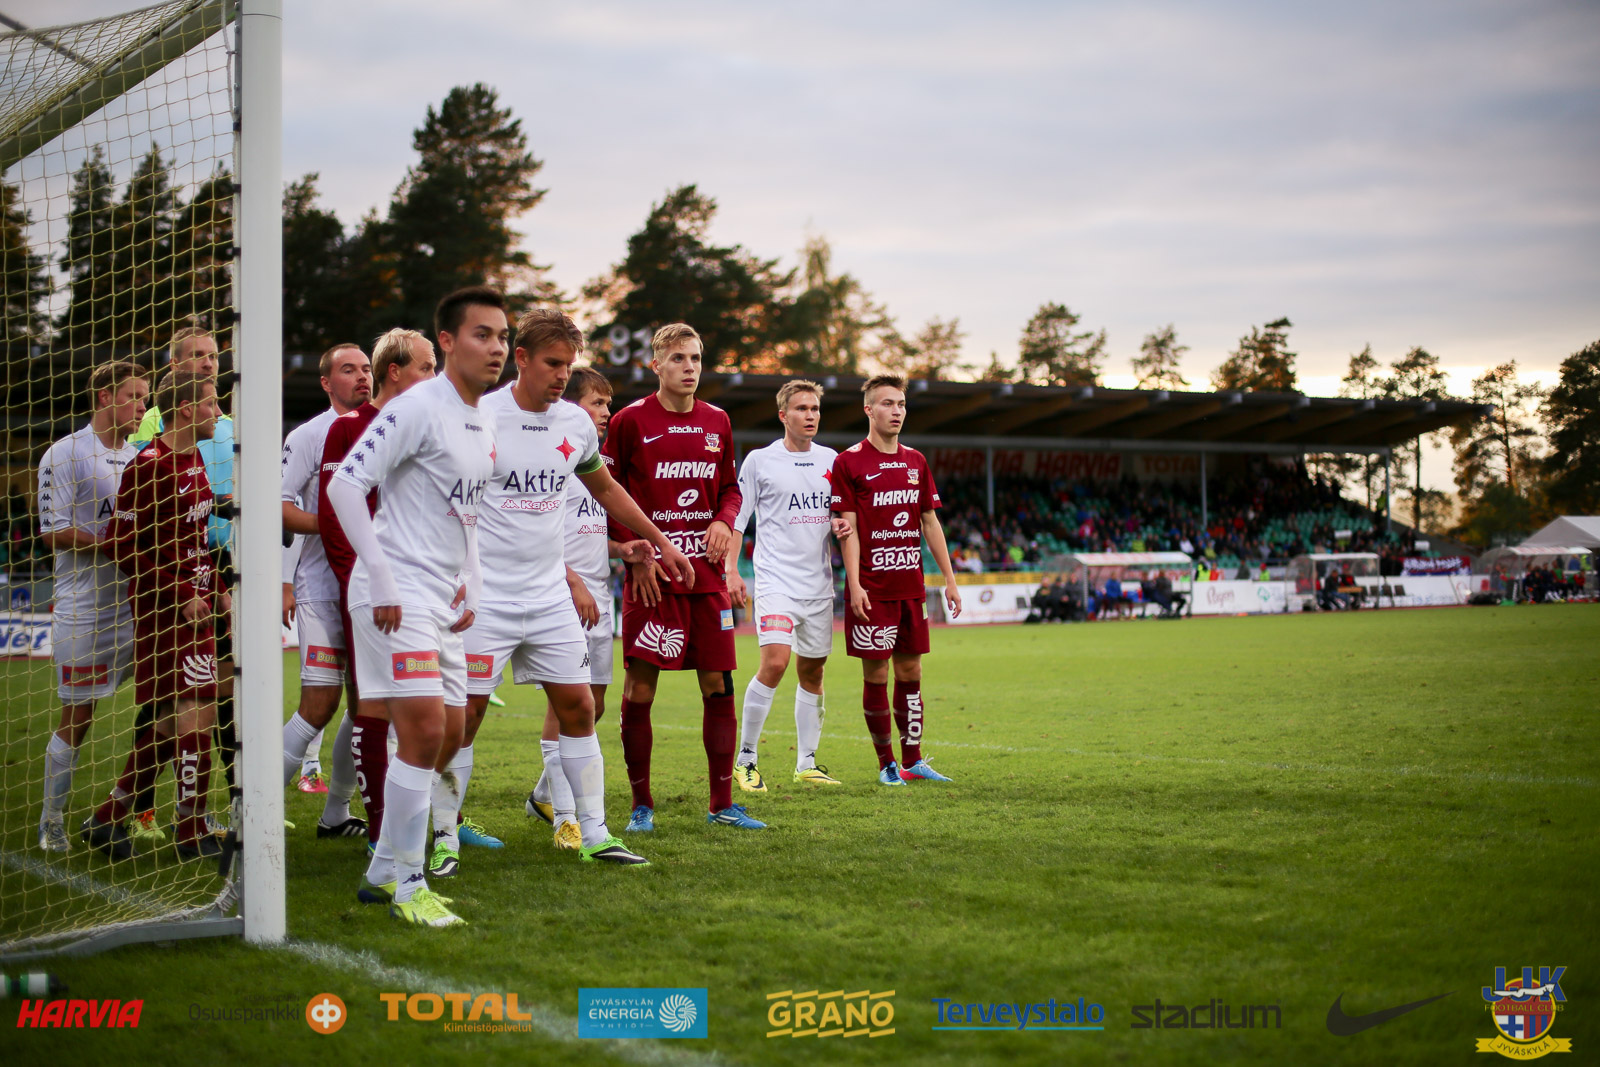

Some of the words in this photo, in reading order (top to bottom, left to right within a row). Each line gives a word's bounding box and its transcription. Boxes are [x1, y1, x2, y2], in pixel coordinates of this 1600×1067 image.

[668, 425, 703, 434] stadium
[655, 462, 717, 479] HARVIA
[879, 461, 908, 470] stadium
[1036, 452, 1121, 478] HARVIA
[503, 469, 566, 493] Aktia
[448, 478, 486, 505] Akti
[873, 490, 919, 506] HARVIA
[521, 500, 561, 511] Kappa
[788, 491, 830, 511] Aktia
[656, 536, 707, 554] RAN
[872, 552, 920, 566] GRANO
[905, 691, 922, 746] TOTAL
